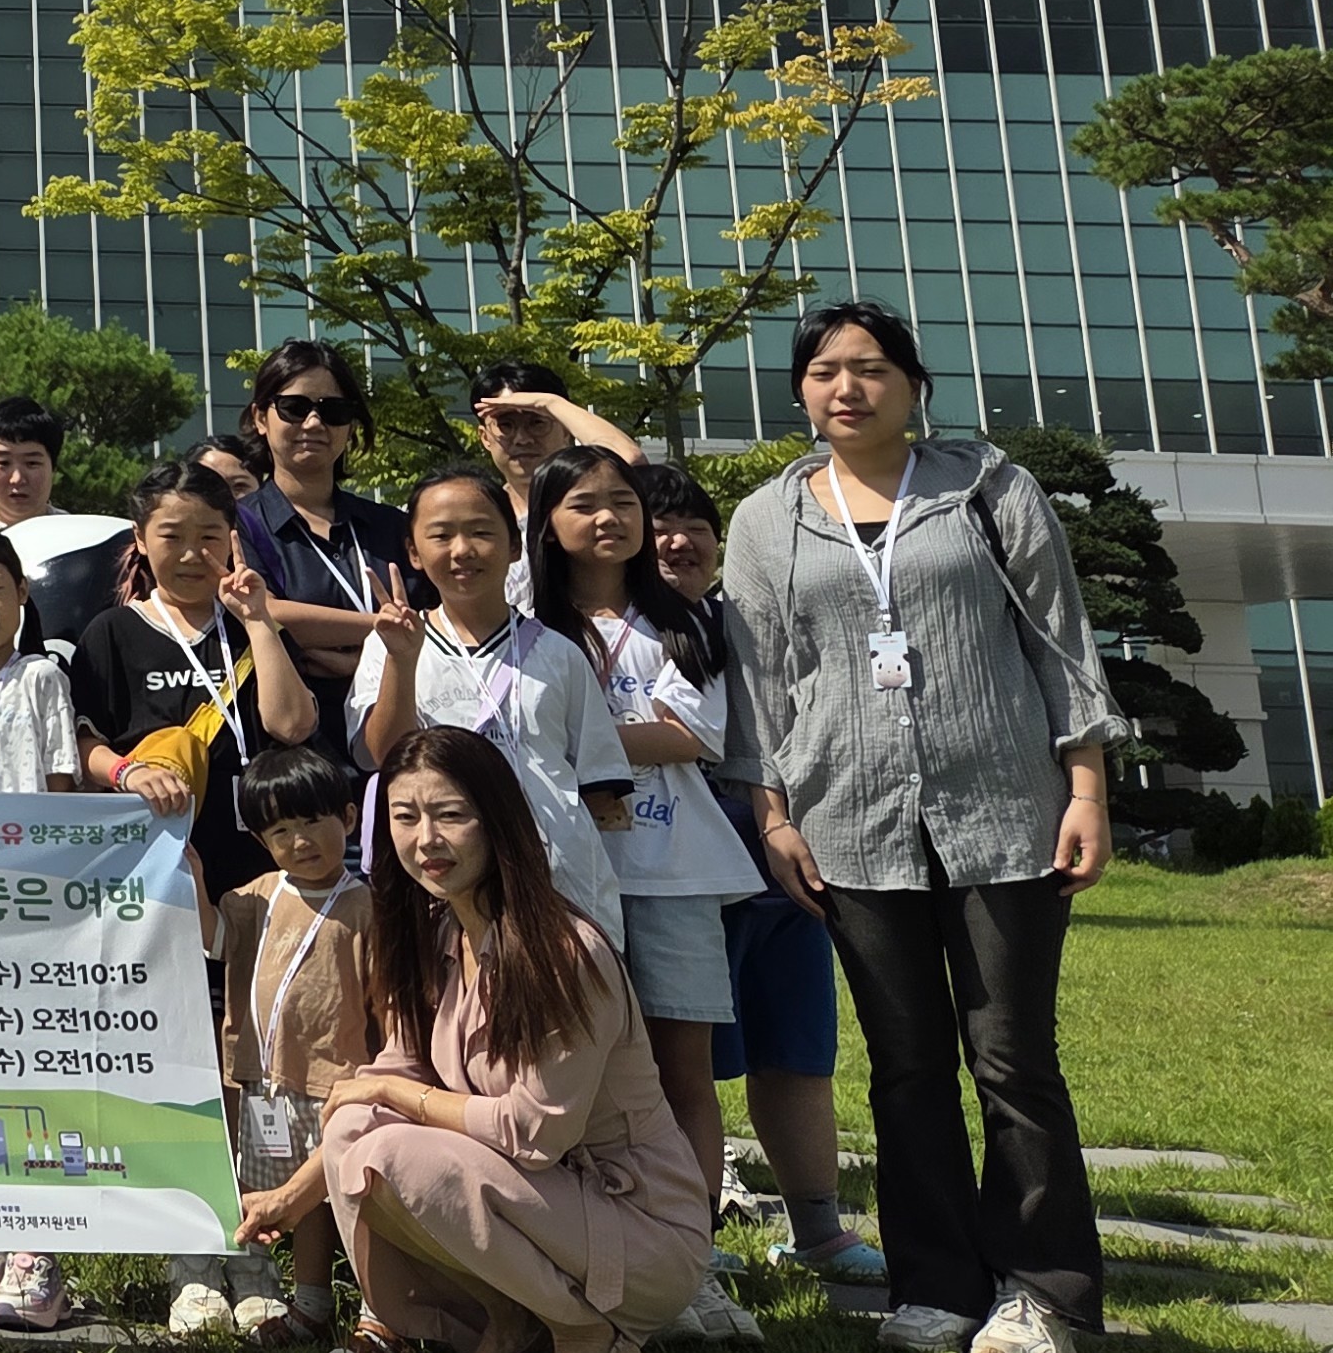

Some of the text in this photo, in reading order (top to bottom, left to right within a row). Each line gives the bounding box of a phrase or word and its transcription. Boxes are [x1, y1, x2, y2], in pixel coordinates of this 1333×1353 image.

[146, 669, 226, 690] SWEE
[29, 824, 104, 845] 양주공장
[111, 824, 148, 845] 견학
[64, 875, 146, 922] 여행
[29, 961, 148, 987] 오전10:15
[32, 1007, 158, 1033] 오전10:00
[33, 1049, 154, 1075] 오전10:15
